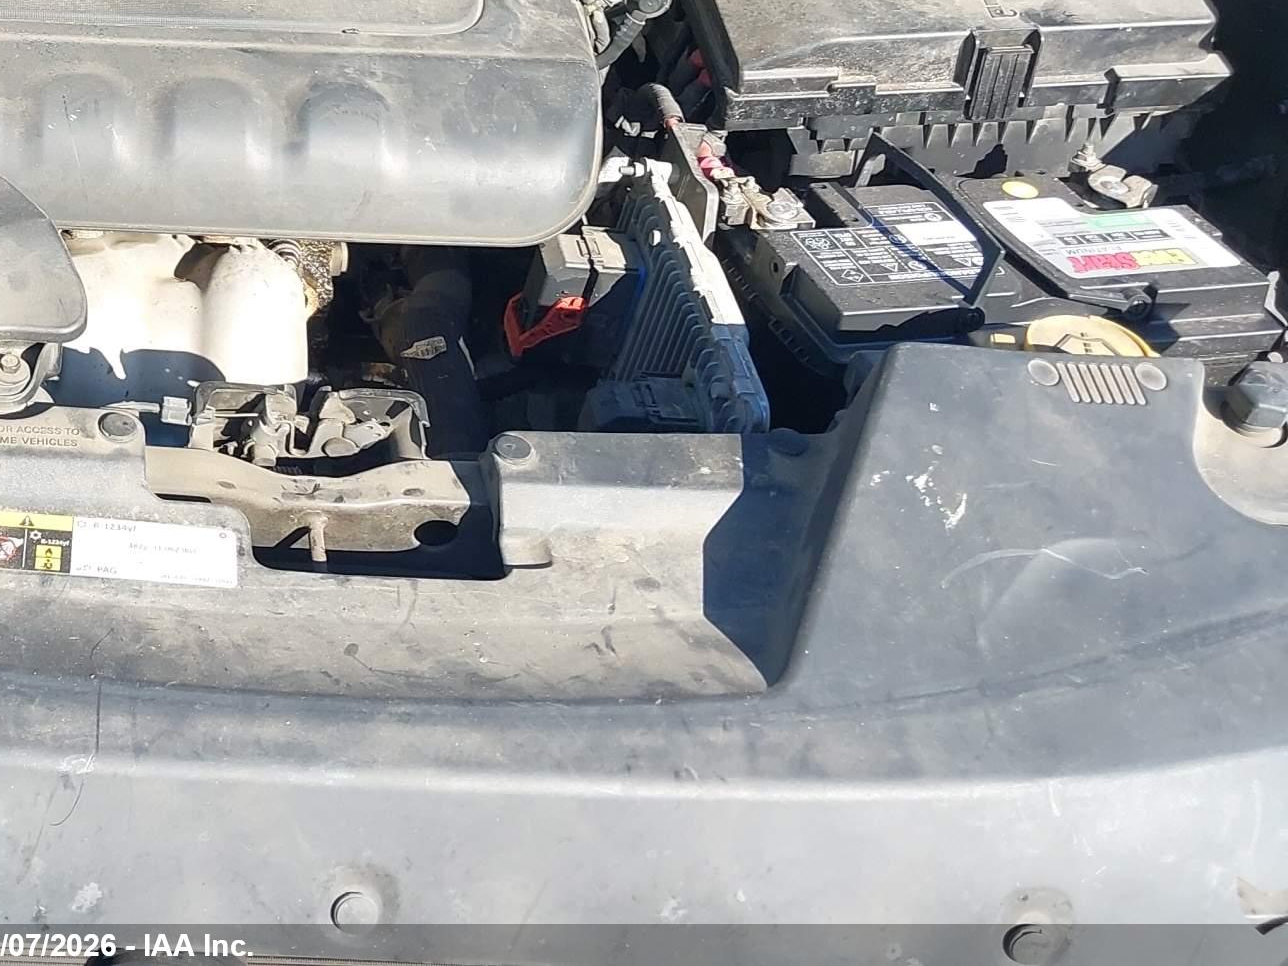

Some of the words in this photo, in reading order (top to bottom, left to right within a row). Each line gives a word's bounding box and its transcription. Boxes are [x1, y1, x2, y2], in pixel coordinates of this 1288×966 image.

[15, 425, 61, 435] ACCESS
[64, 427, 80, 436] TO
[22, 436, 78, 447] VEHICLES
